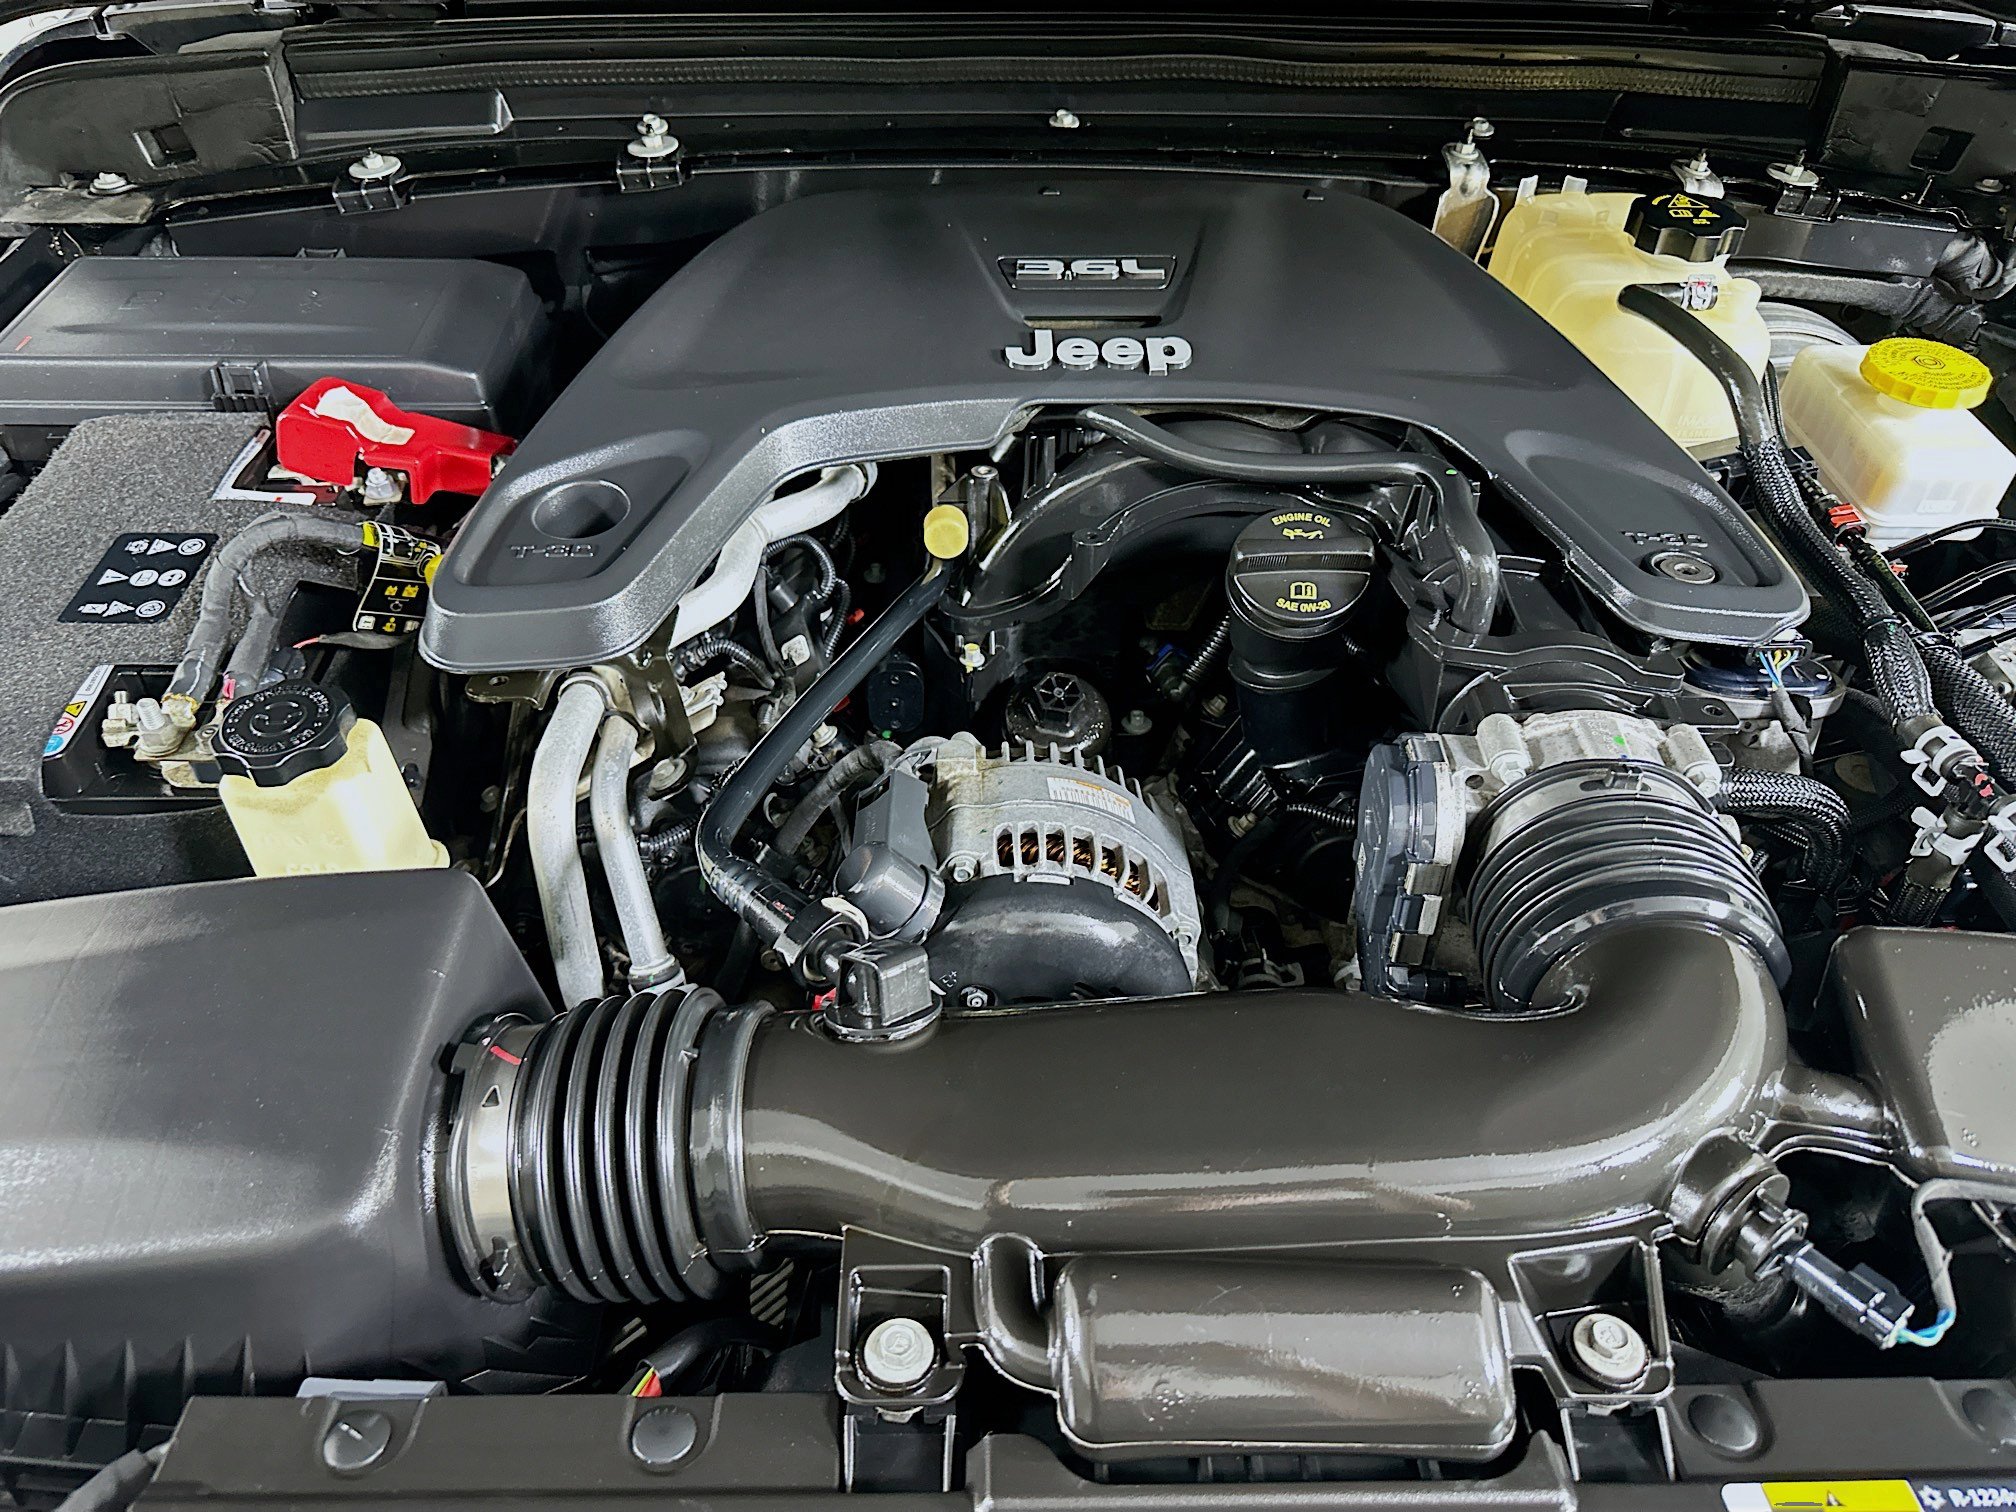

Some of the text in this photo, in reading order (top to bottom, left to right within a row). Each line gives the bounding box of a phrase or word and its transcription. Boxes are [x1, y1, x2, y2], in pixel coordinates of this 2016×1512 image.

[1016, 259, 1165, 280] 3.6L
[1005, 329, 1193, 376] Jeep
[1271, 512, 1332, 528] ENGINE OIL
[1275, 598, 1332, 613] SAE 0W-20
